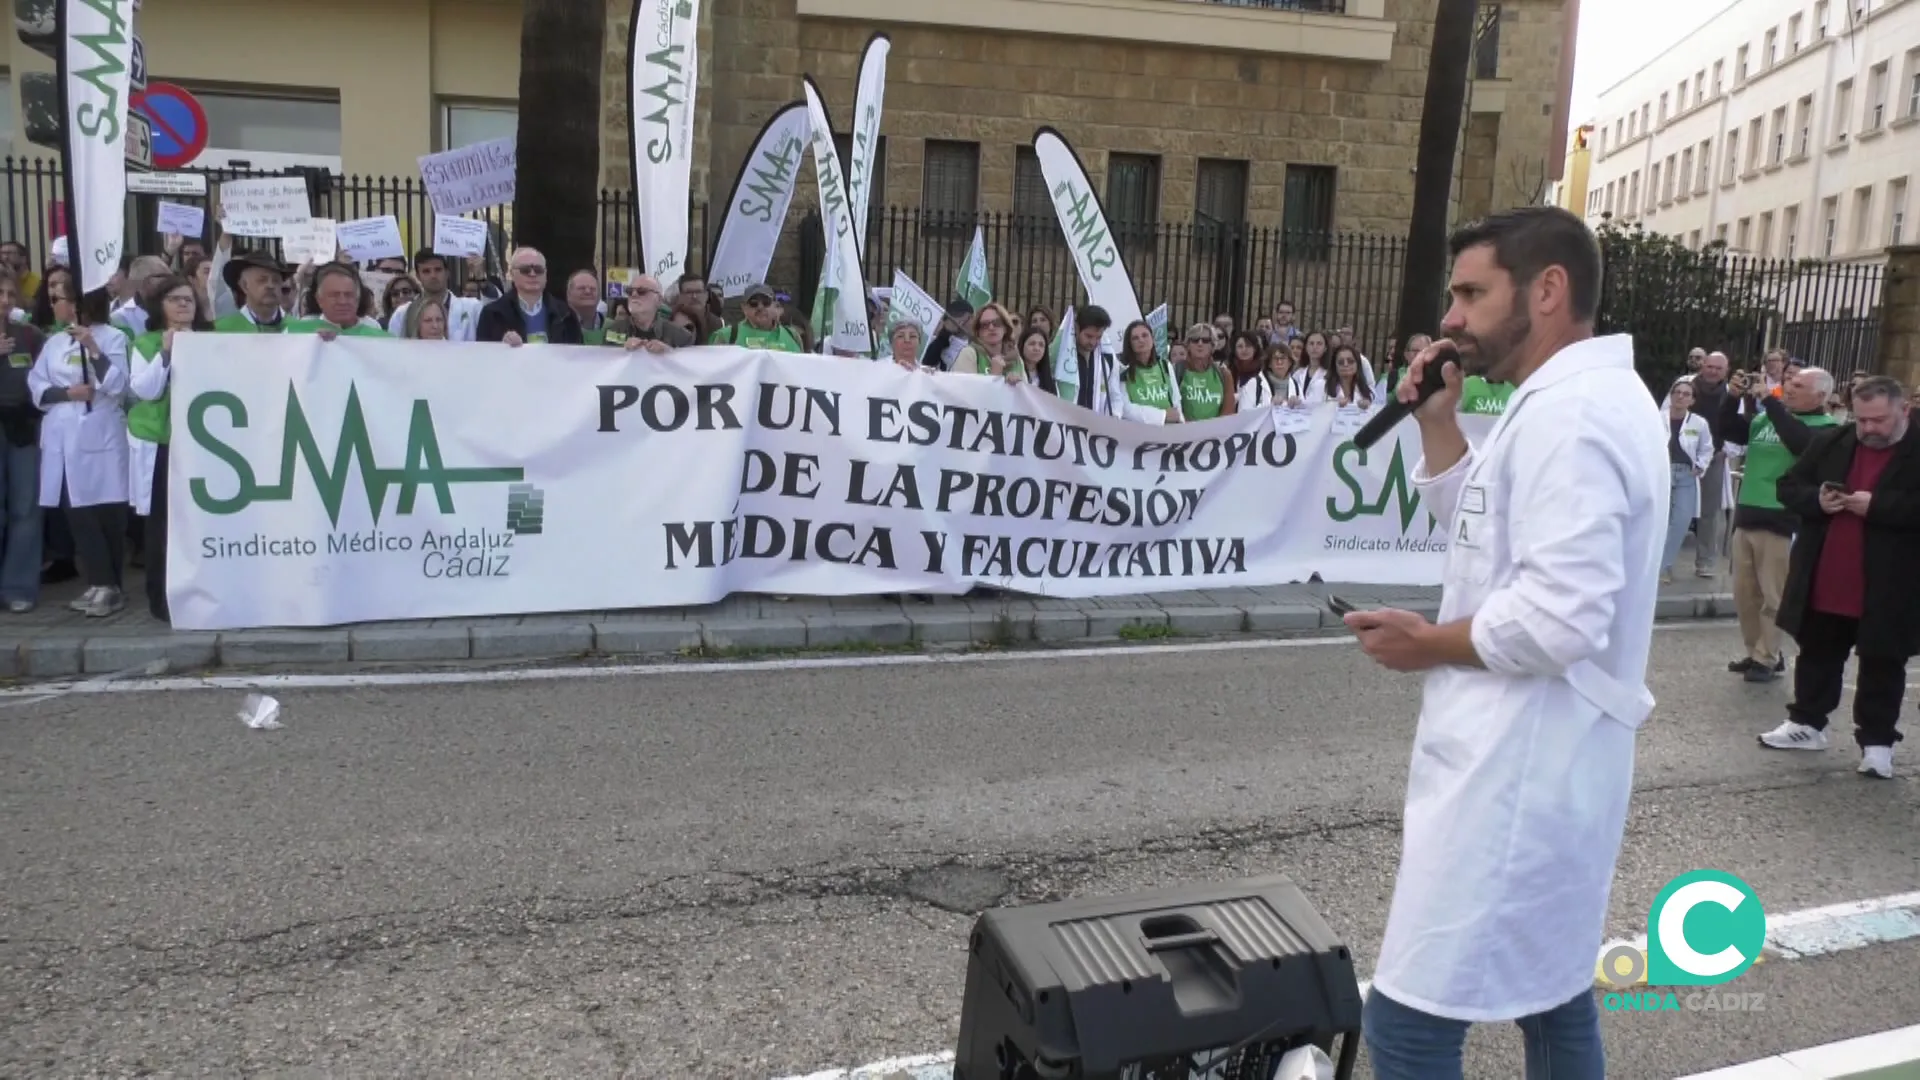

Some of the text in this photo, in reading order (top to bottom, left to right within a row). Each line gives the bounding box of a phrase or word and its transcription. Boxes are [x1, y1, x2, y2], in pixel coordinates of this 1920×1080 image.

[640, 44, 685, 164] SMA
[740, 145, 795, 222] SMA
[187, 378, 500, 530] SMA
[596, 382, 1297, 472] POR UN ESTATUTO PROPIO
[740, 449, 1207, 528] DE LA PROFESIÓN
[202, 526, 515, 559] Sindicato Médico Andaluz
[422, 547, 511, 579] Cádiz
[919, 530, 948, 575] Y
[961, 533, 1248, 580] FACULTATIVA
[1323, 534, 1448, 553] Sindicato Médico
